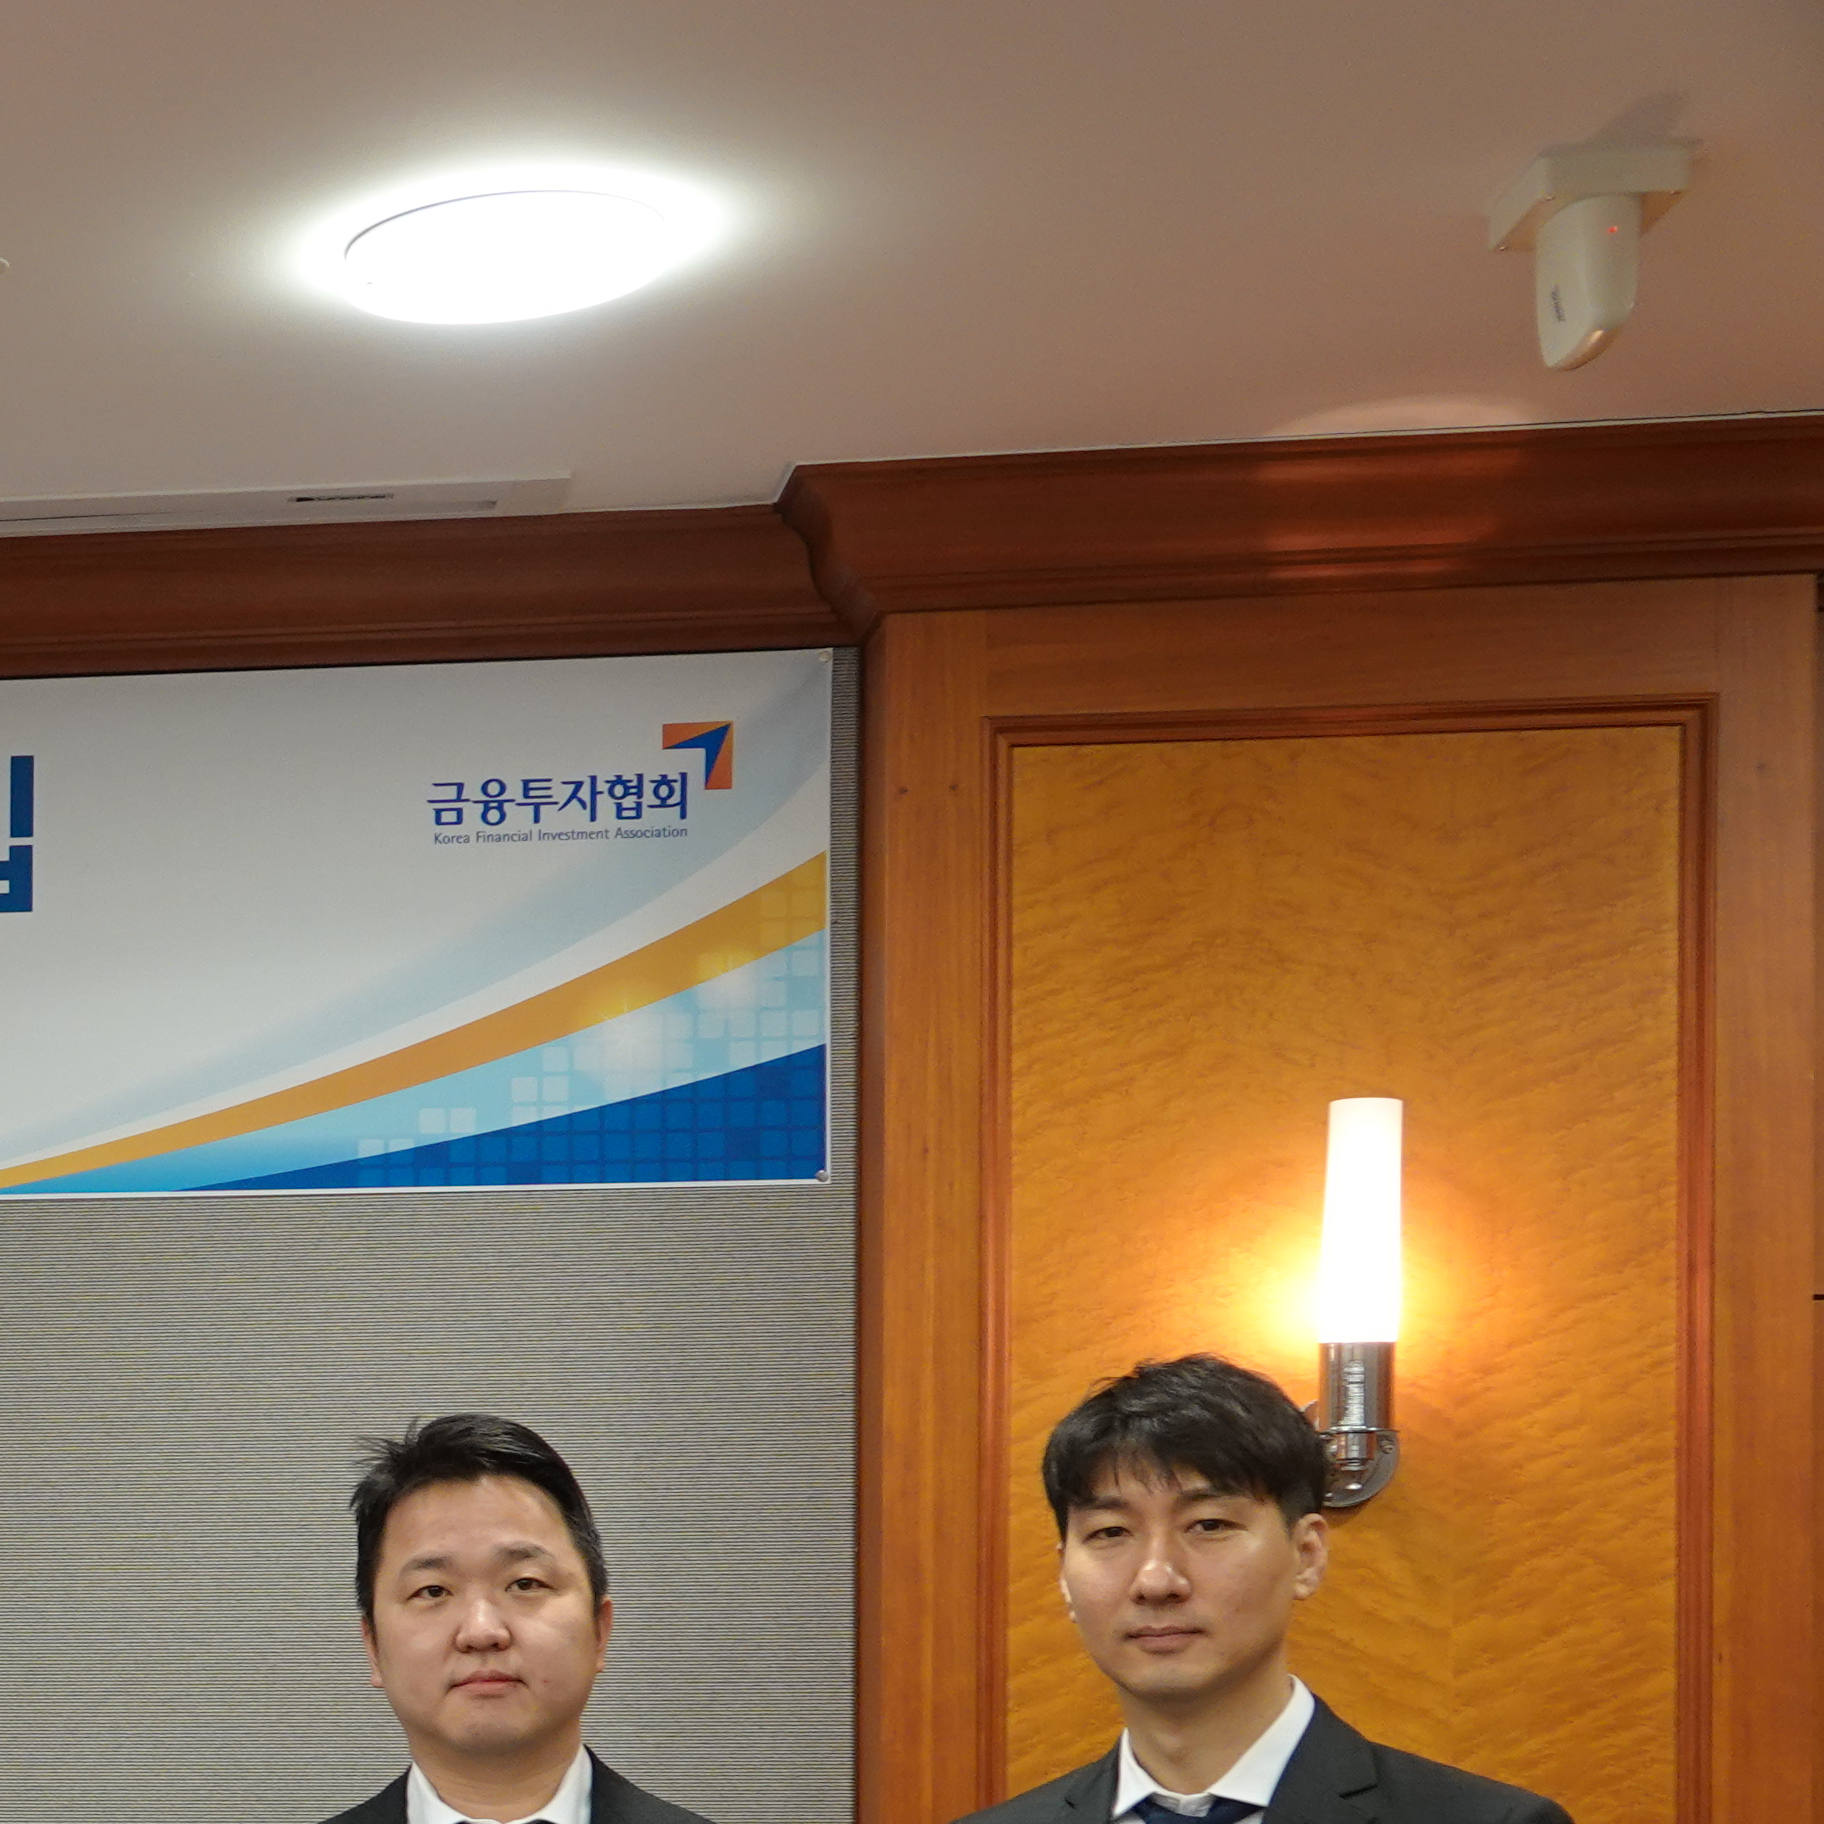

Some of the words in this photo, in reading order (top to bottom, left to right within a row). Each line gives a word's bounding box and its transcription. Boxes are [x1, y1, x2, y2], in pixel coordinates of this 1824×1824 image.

[426, 771, 689, 827] 금융투자협회
[433, 830, 471, 846] Korea
[475, 828, 534, 844] Financial
[537, 827, 611, 843] Investment
[614, 825, 689, 841] Association
